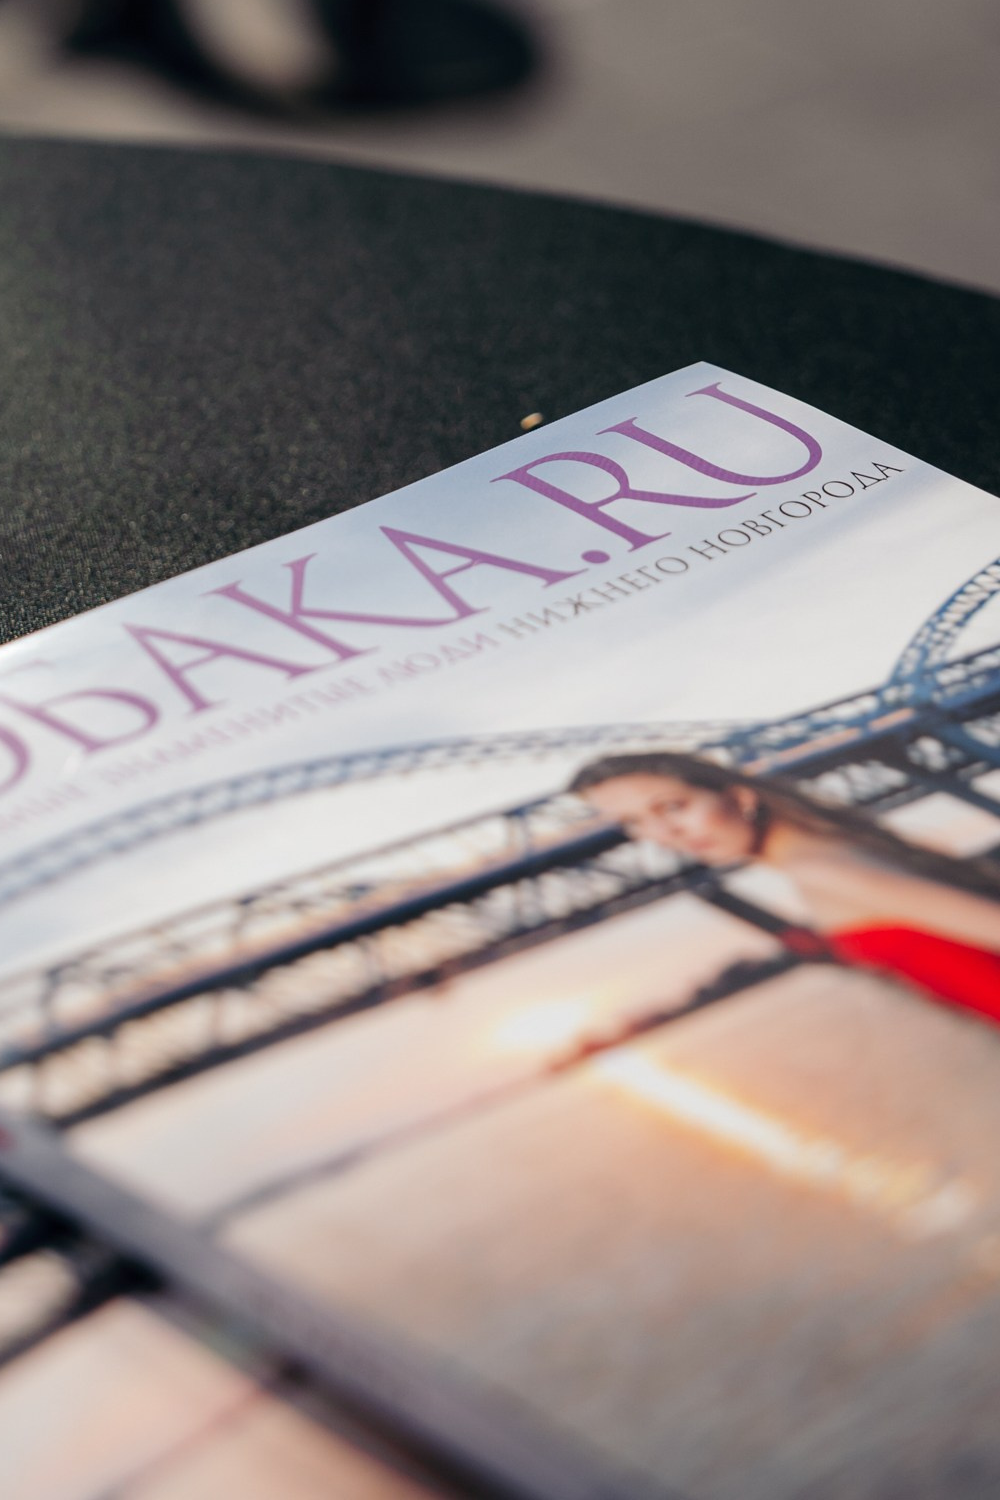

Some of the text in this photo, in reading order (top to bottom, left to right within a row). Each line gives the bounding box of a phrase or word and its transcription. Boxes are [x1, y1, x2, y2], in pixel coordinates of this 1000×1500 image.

[376, 632, 500, 686] ЛЮДИ
[496, 555, 690, 640] НИЖНЕГО
[687, 460, 905, 562] НОВГОРОДА
